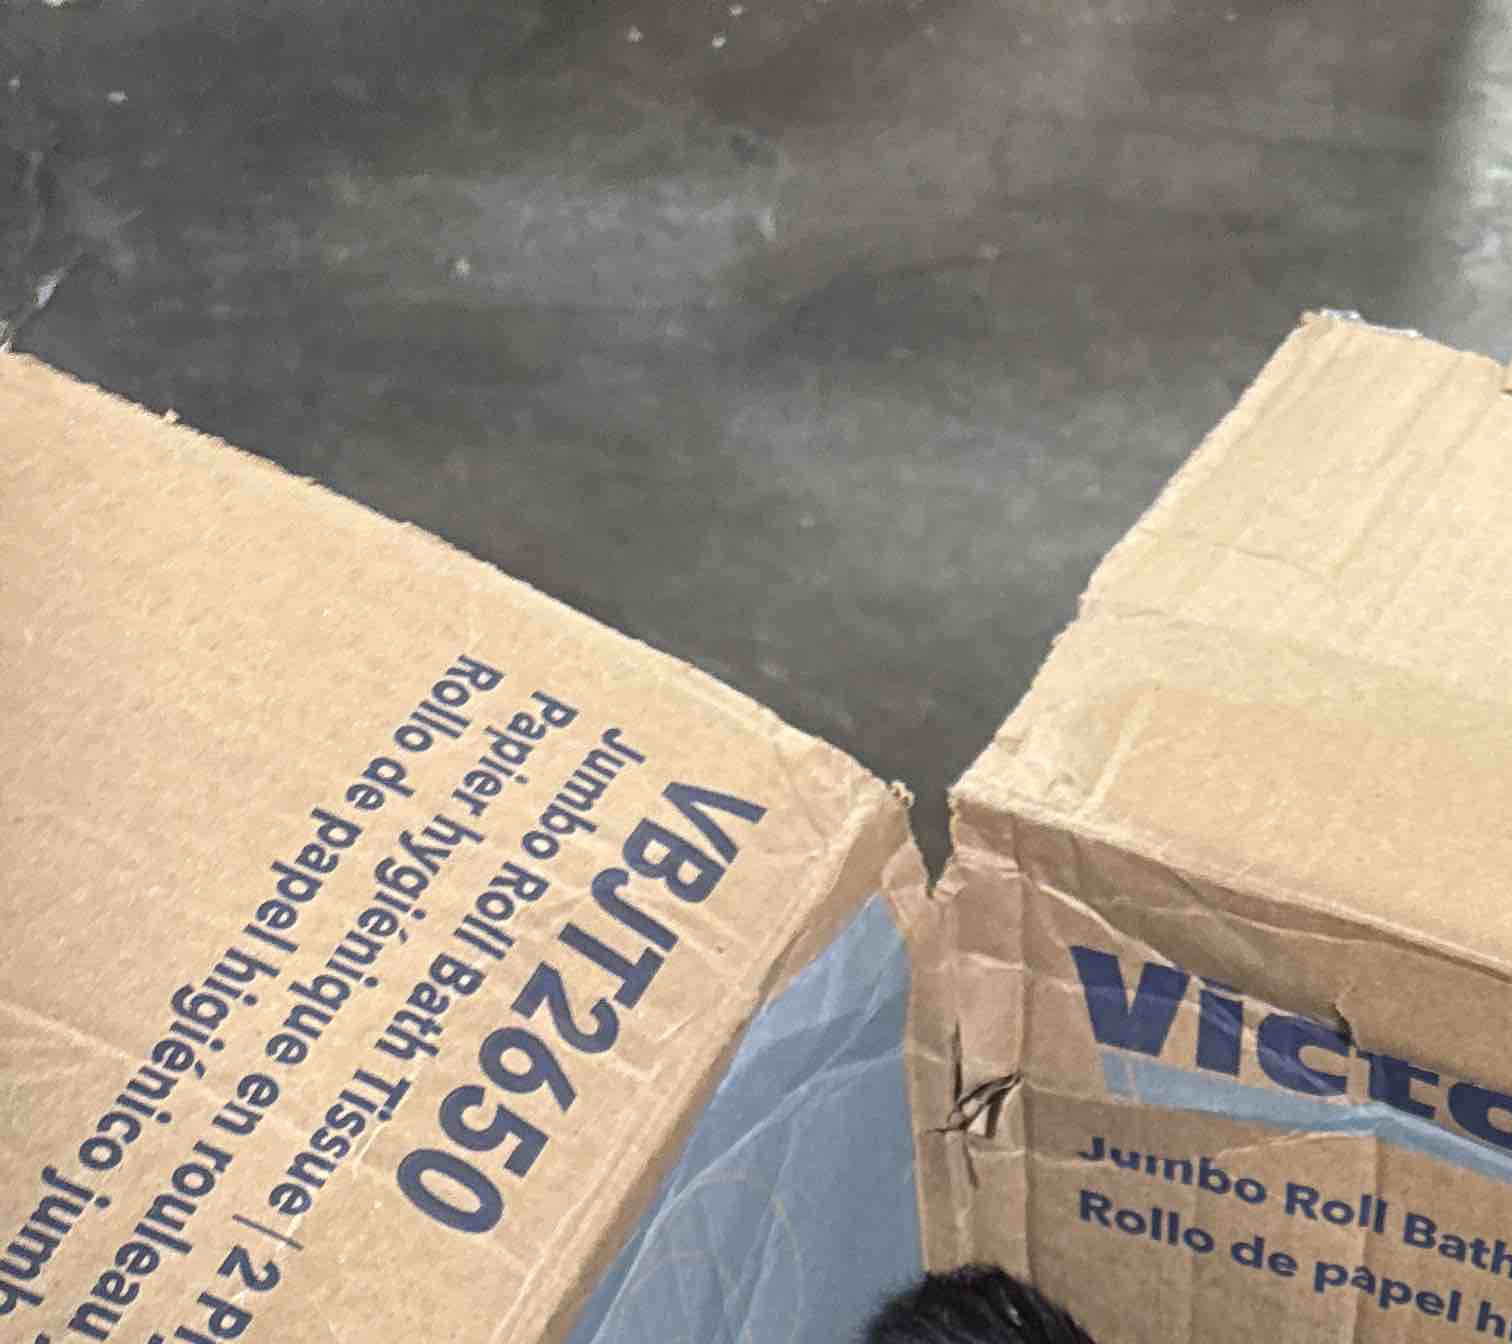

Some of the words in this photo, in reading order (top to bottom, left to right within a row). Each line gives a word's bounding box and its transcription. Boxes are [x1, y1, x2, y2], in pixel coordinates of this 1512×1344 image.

[394, 654, 505, 754] Rollo
[461, 690, 579, 821] Papier
[344, 754, 417, 813] de
[523, 727, 646, 861] Jumbo
[243, 807, 364, 956] papel
[265, 813, 488, 1068] hygiénique
[455, 861, 549, 962] Roll
[78, 944, 281, 1172] higiénico
[374, 951, 484, 1067] Bath
[394, 780, 768, 1236] VBJT2650
[210, 1071, 281, 1139] en
[268, 1066, 411, 1220] Tissue
[0, 1167, 112, 1317] jumb
[69, 1140, 233, 1342] rouleau
[1077, 1134, 1268, 1205] Jumbo
[1284, 1182, 1388, 1235] Roll
[222, 1245, 283, 1293] 2
[1078, 1189, 1216, 1255] Rollo
[1230, 1235, 1298, 1279] de
[1313, 1262, 1463, 1323] papel
